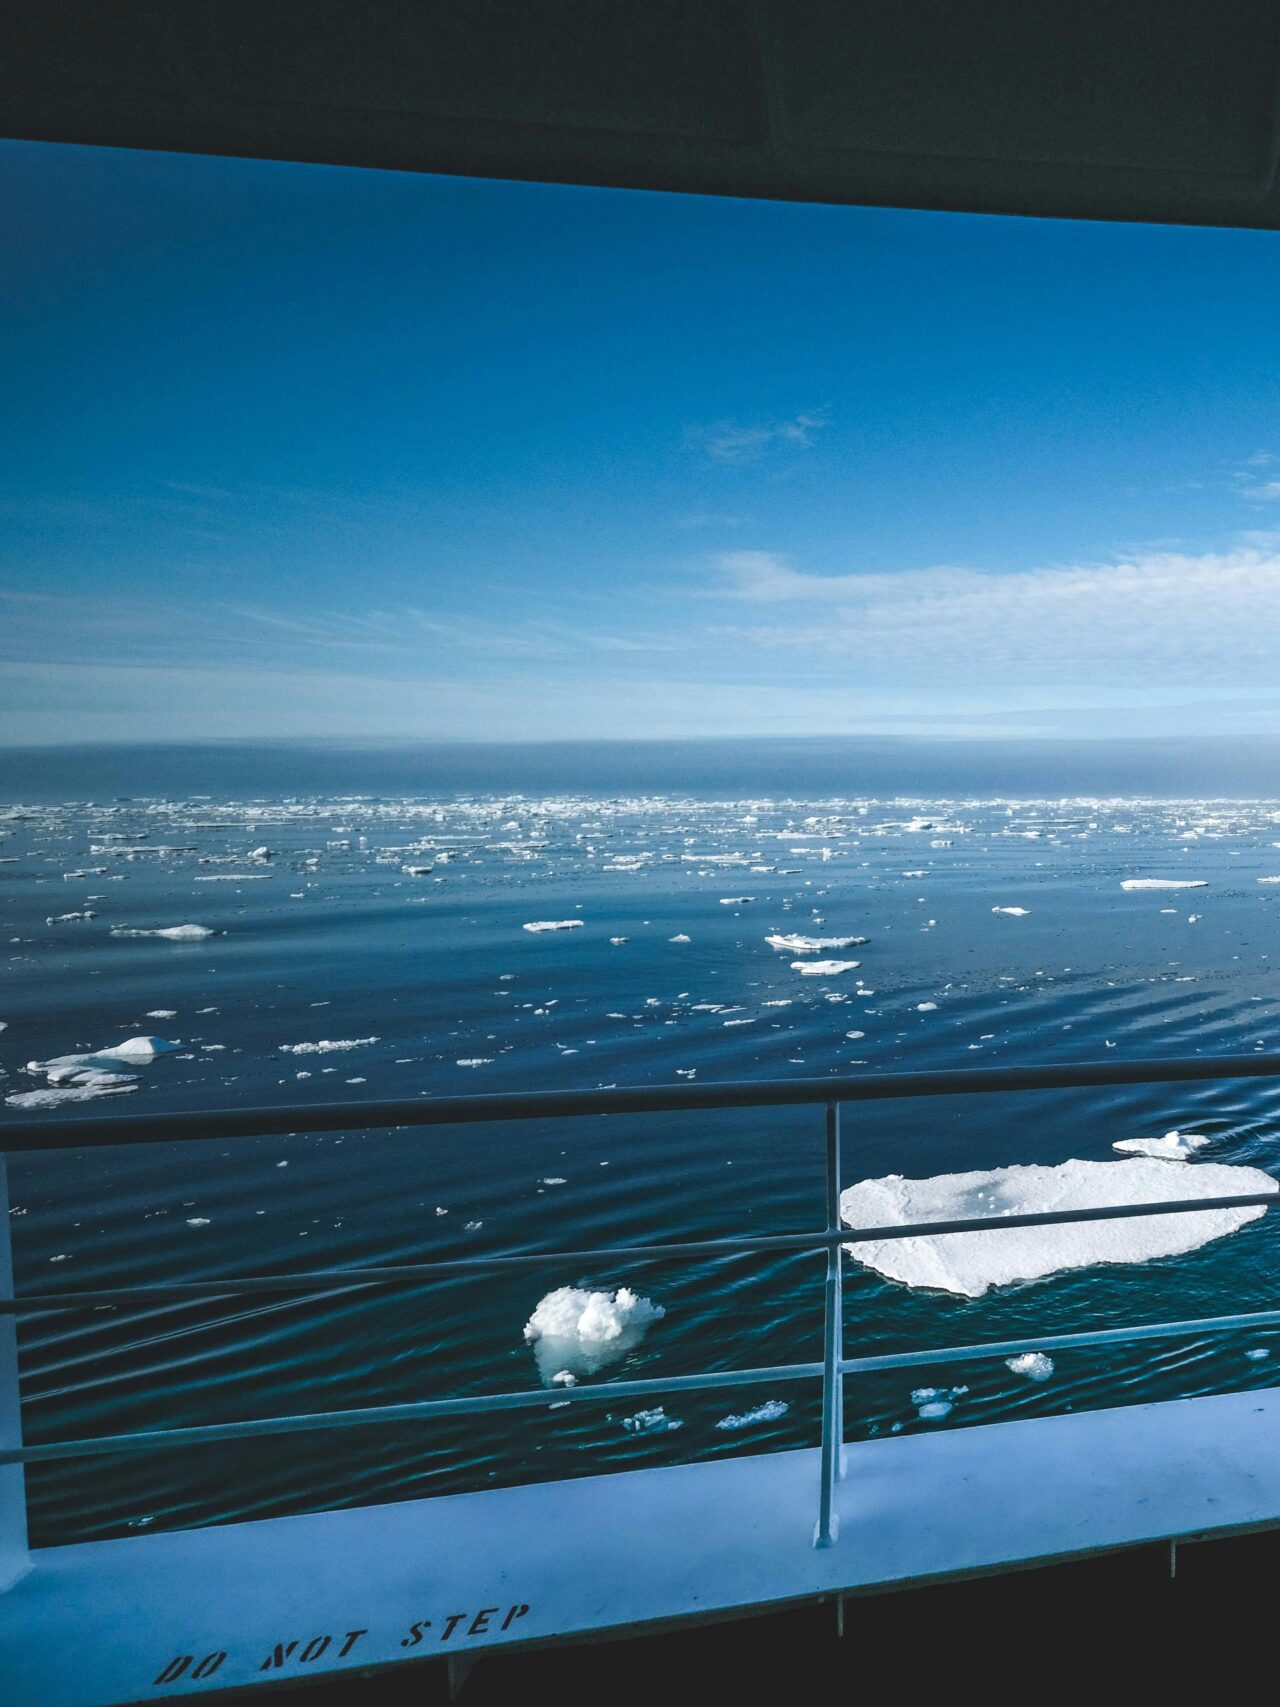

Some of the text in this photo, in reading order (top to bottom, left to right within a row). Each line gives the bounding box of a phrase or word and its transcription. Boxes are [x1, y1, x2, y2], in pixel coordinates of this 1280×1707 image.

[153, 1604, 531, 1686] DO NOT STEP
